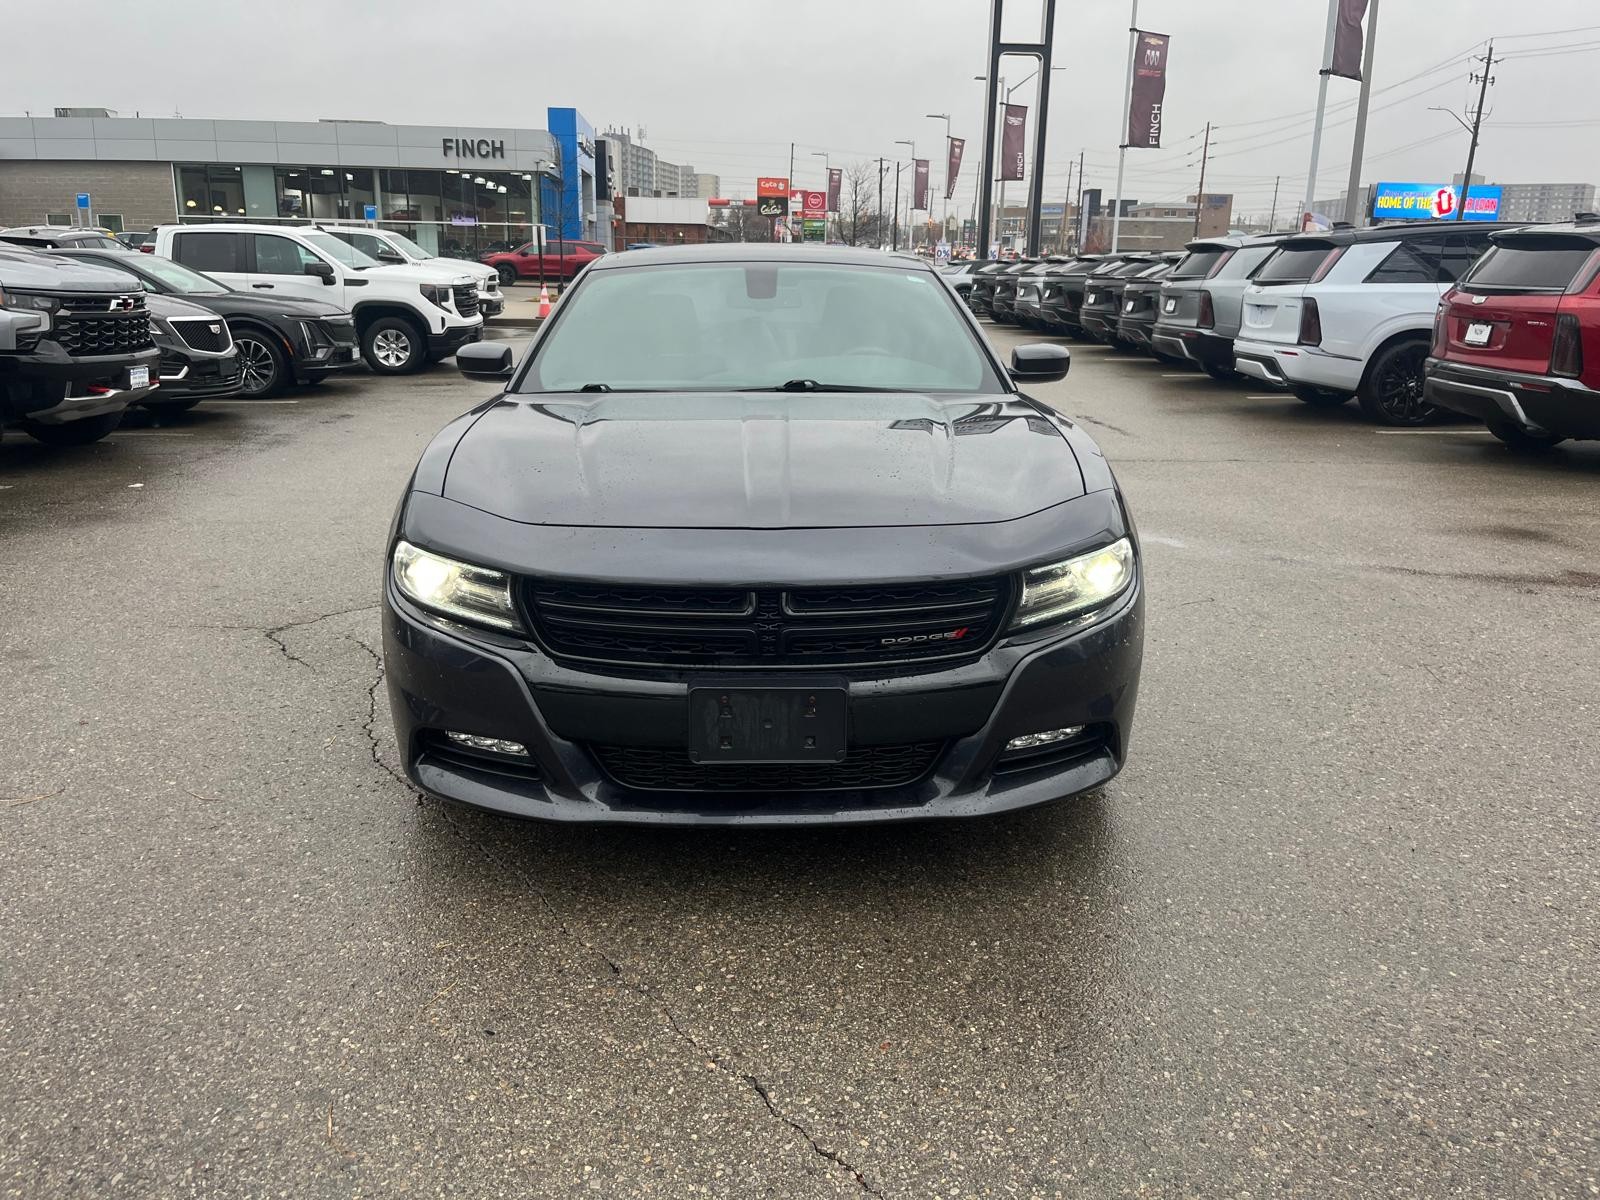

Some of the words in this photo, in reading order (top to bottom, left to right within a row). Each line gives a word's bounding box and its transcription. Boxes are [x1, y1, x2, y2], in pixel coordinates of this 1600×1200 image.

[1149, 103, 1161, 145] FINCH
[442, 138, 505, 159] FINCH
[1017, 152, 1025, 178] FINCH
[1377, 196, 1402, 209] HOME
[1403, 197, 1415, 208] OF
[1416, 197, 1432, 210] THE
[936, 249, 951, 258] 0%
[881, 632, 954, 645] DODGE
